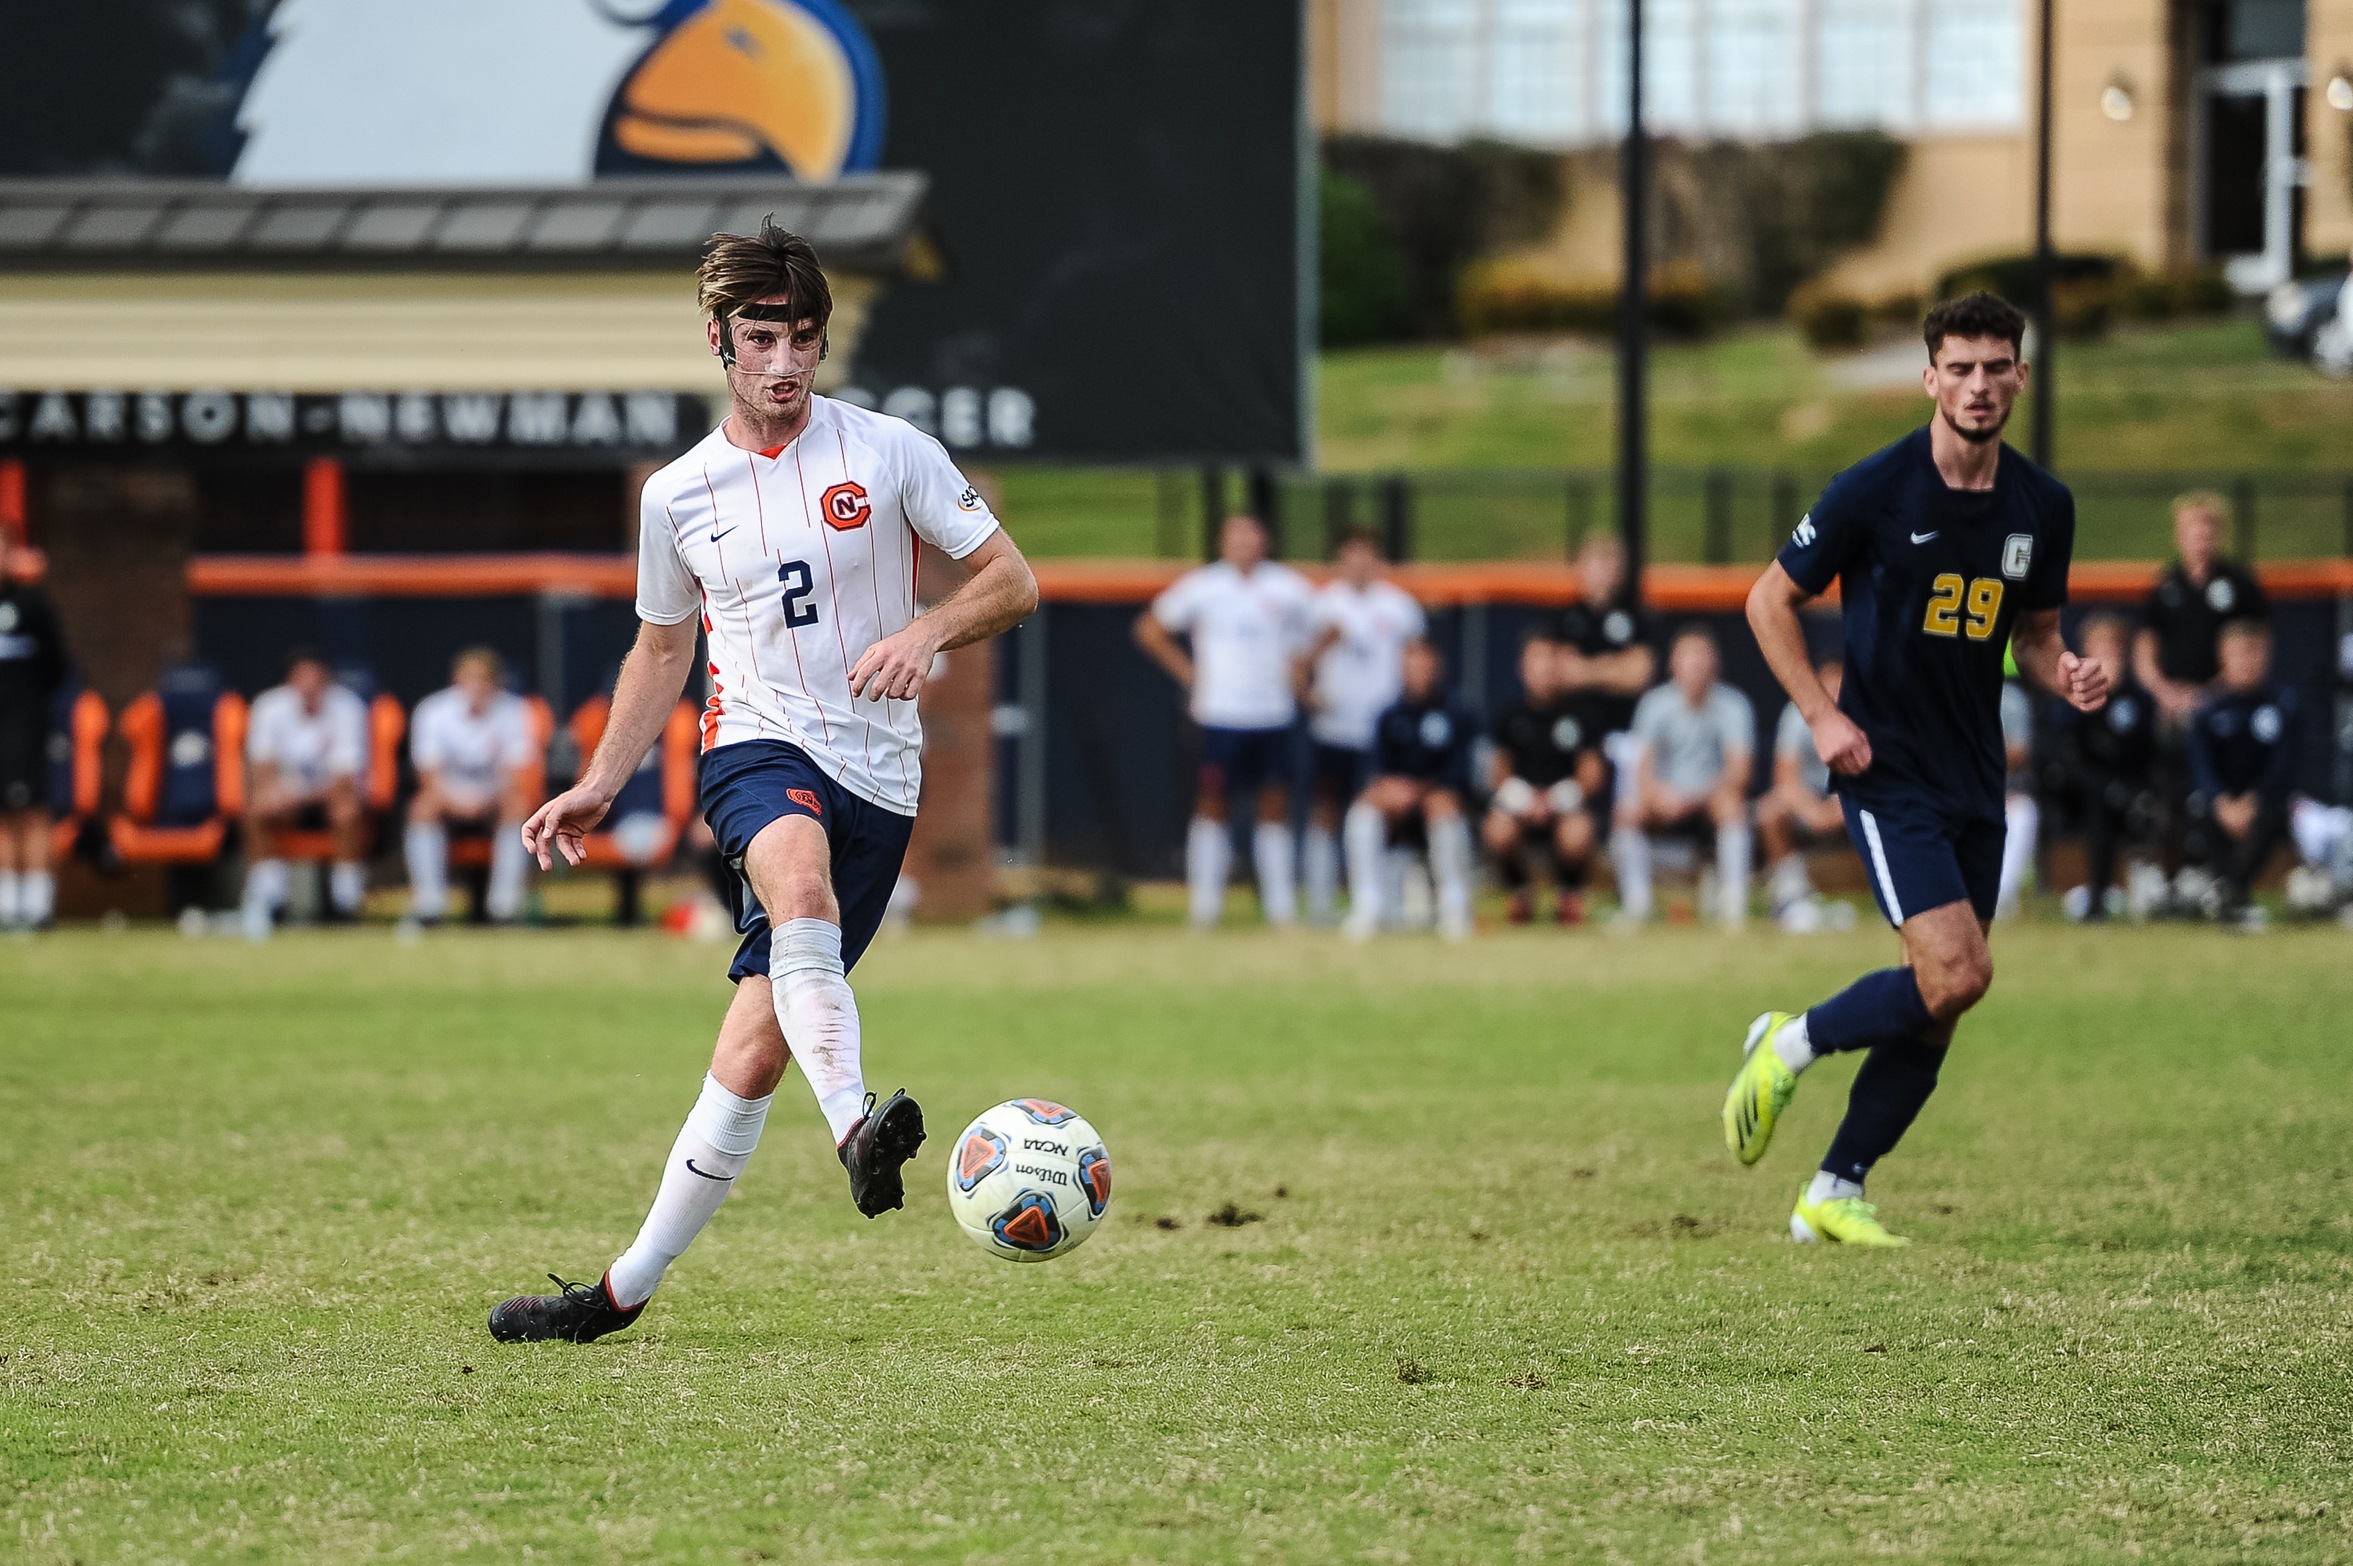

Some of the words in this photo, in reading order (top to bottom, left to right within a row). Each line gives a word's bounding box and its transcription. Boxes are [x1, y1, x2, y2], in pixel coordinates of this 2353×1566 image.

[2002, 533, 2034, 581] C
[778, 559, 819, 629] 2
[1923, 573, 2004, 641] 29
[1024, 1138, 1069, 1157] NCAA
[1016, 1163, 1068, 1186] Wilson
